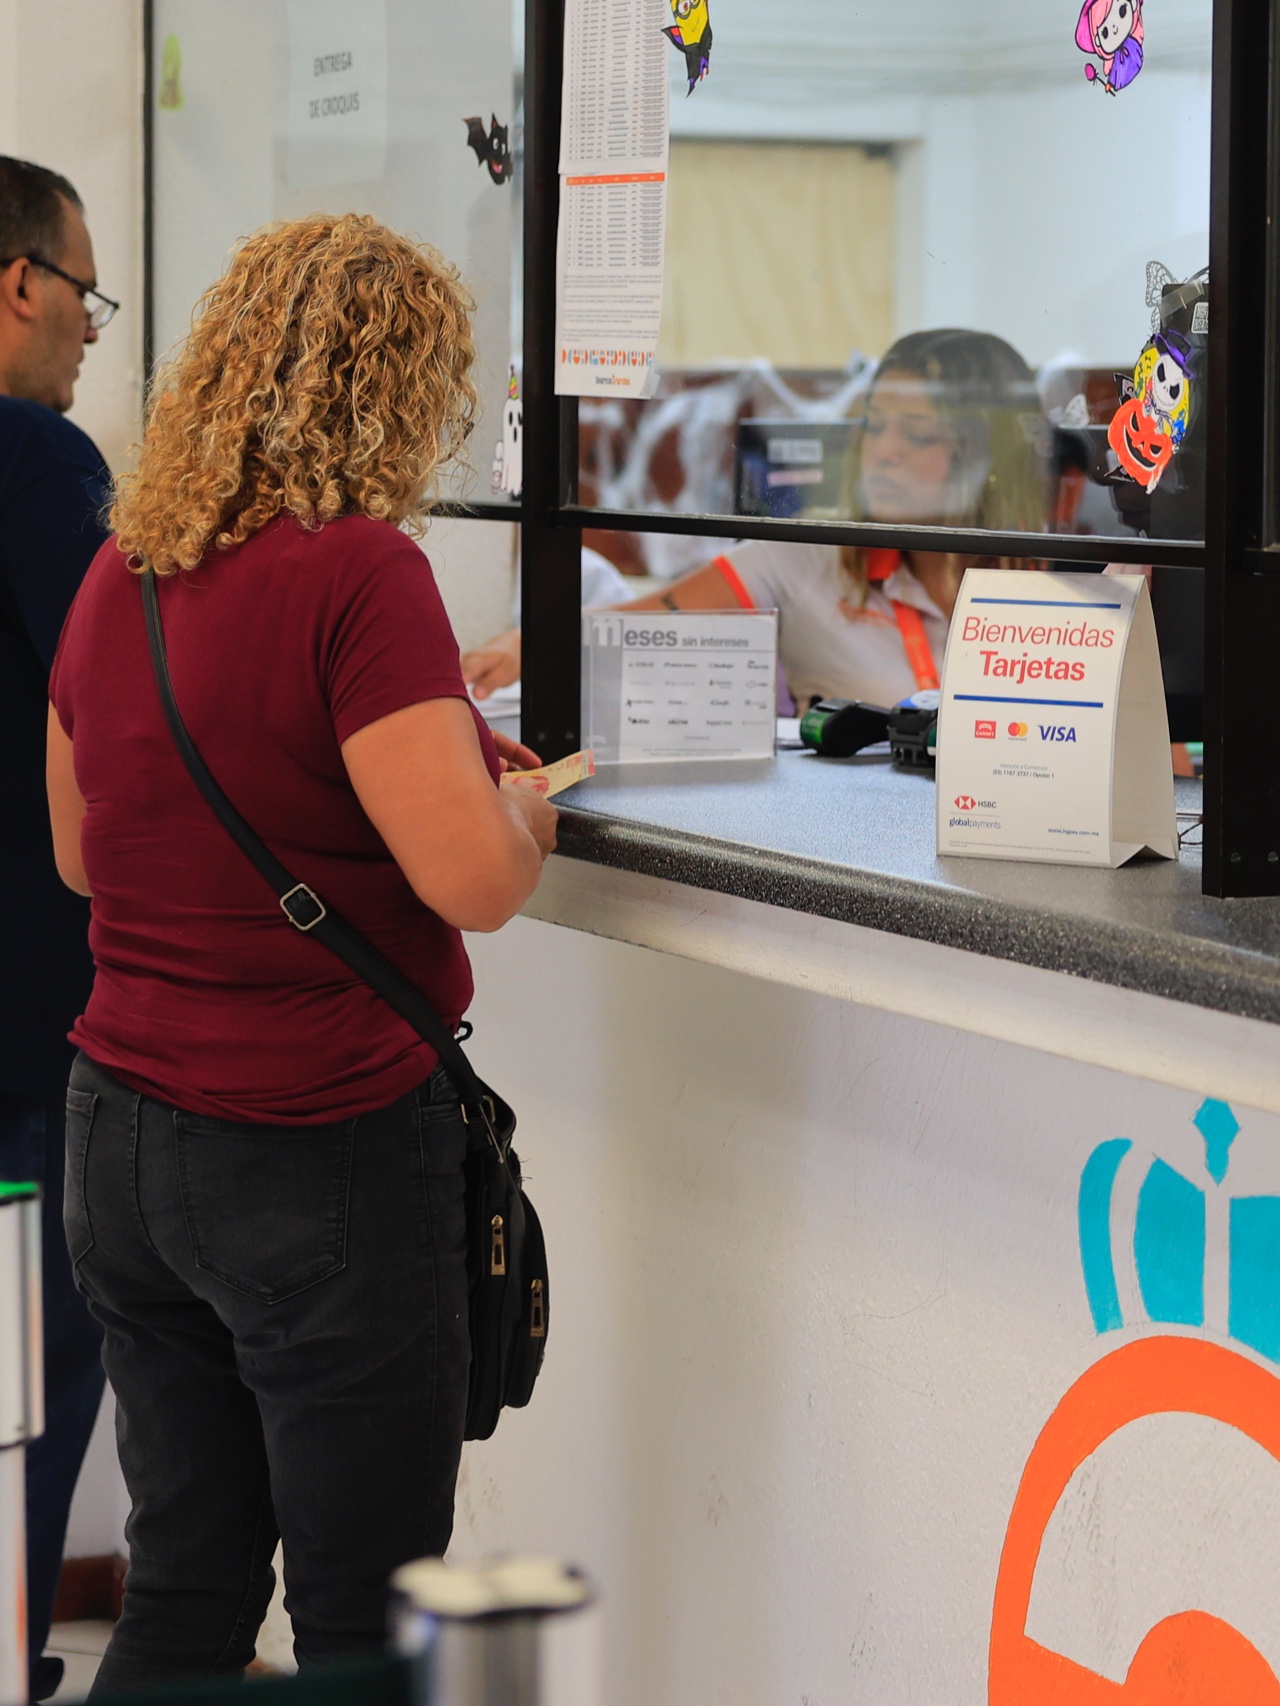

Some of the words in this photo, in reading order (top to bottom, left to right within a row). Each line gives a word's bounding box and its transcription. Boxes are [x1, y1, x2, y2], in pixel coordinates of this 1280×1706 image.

[313, 52, 352, 77] ENTREGA
[308, 100, 320, 119] DE
[322, 91, 360, 116] CROQUIS
[962, 616, 1115, 649] Bienvenidas
[682, 635, 698, 647] sin
[700, 635, 749, 648] intereses
[979, 650, 1086, 684] Tarjetas
[1037, 725, 1077, 742] VISA
[1000, 762, 1020, 770] Atención
[1032, 771, 1051, 779] Opción
[978, 801, 997, 809] HSBC
